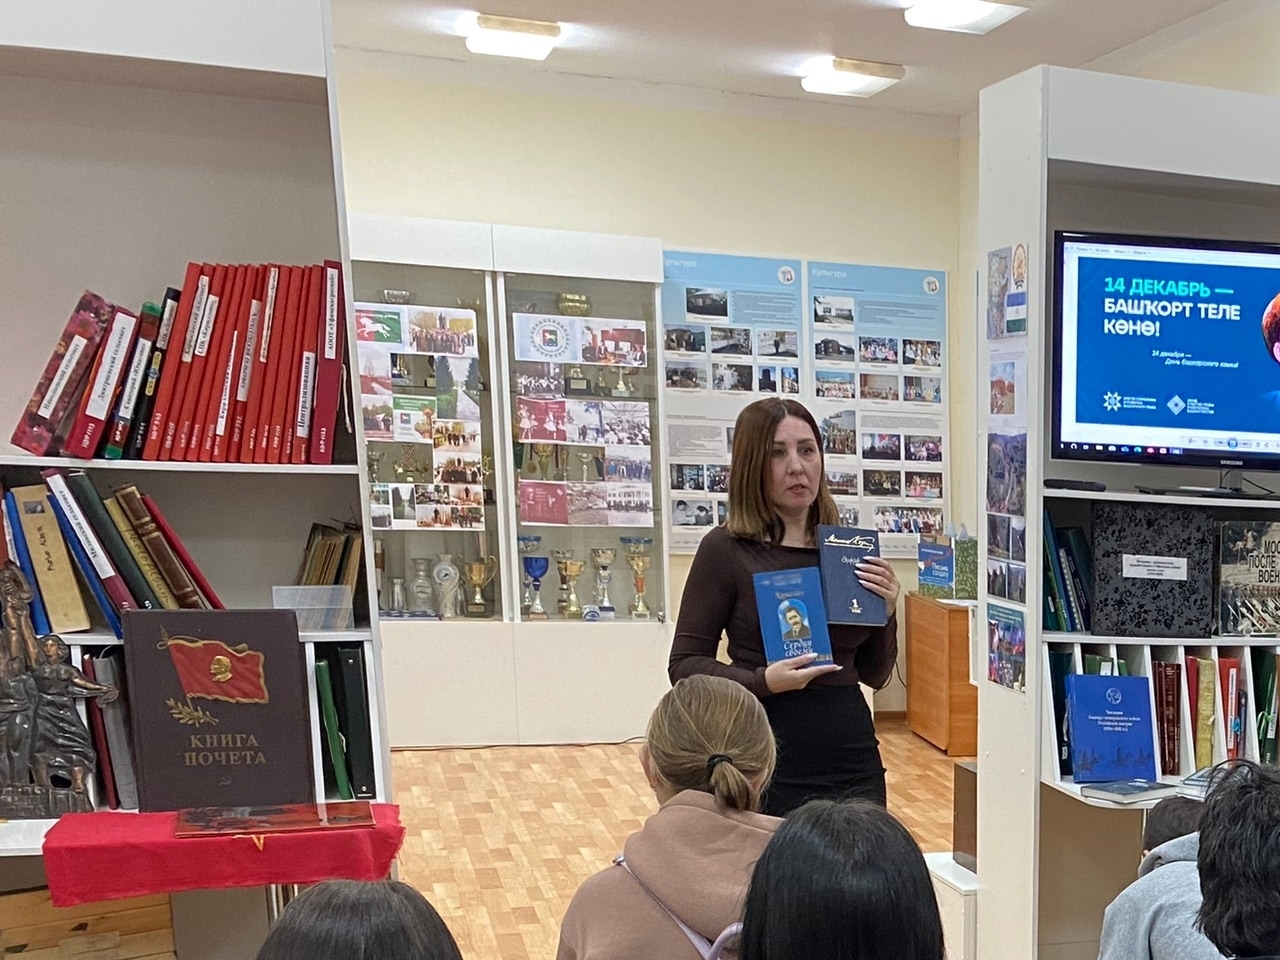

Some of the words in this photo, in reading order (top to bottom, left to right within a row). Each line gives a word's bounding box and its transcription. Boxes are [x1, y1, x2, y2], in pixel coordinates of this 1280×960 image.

[811, 267, 848, 279] Культура
[1104, 277, 1125, 293] 14
[1129, 278, 1211, 298] ДЕКАБРЬ
[1197, 302, 1241, 321] ТЕЛЕ
[1103, 318, 1160, 337] КӨНӨ!
[297, 356, 311, 428] Централизованная
[1248, 555, 1276, 569] ПОСЛЕ
[852, 599, 859, 608] 1
[783, 638, 812, 651] Сердцу
[190, 734, 259, 748] КНИГА
[184, 751, 267, 766] ПОЧЕТА
